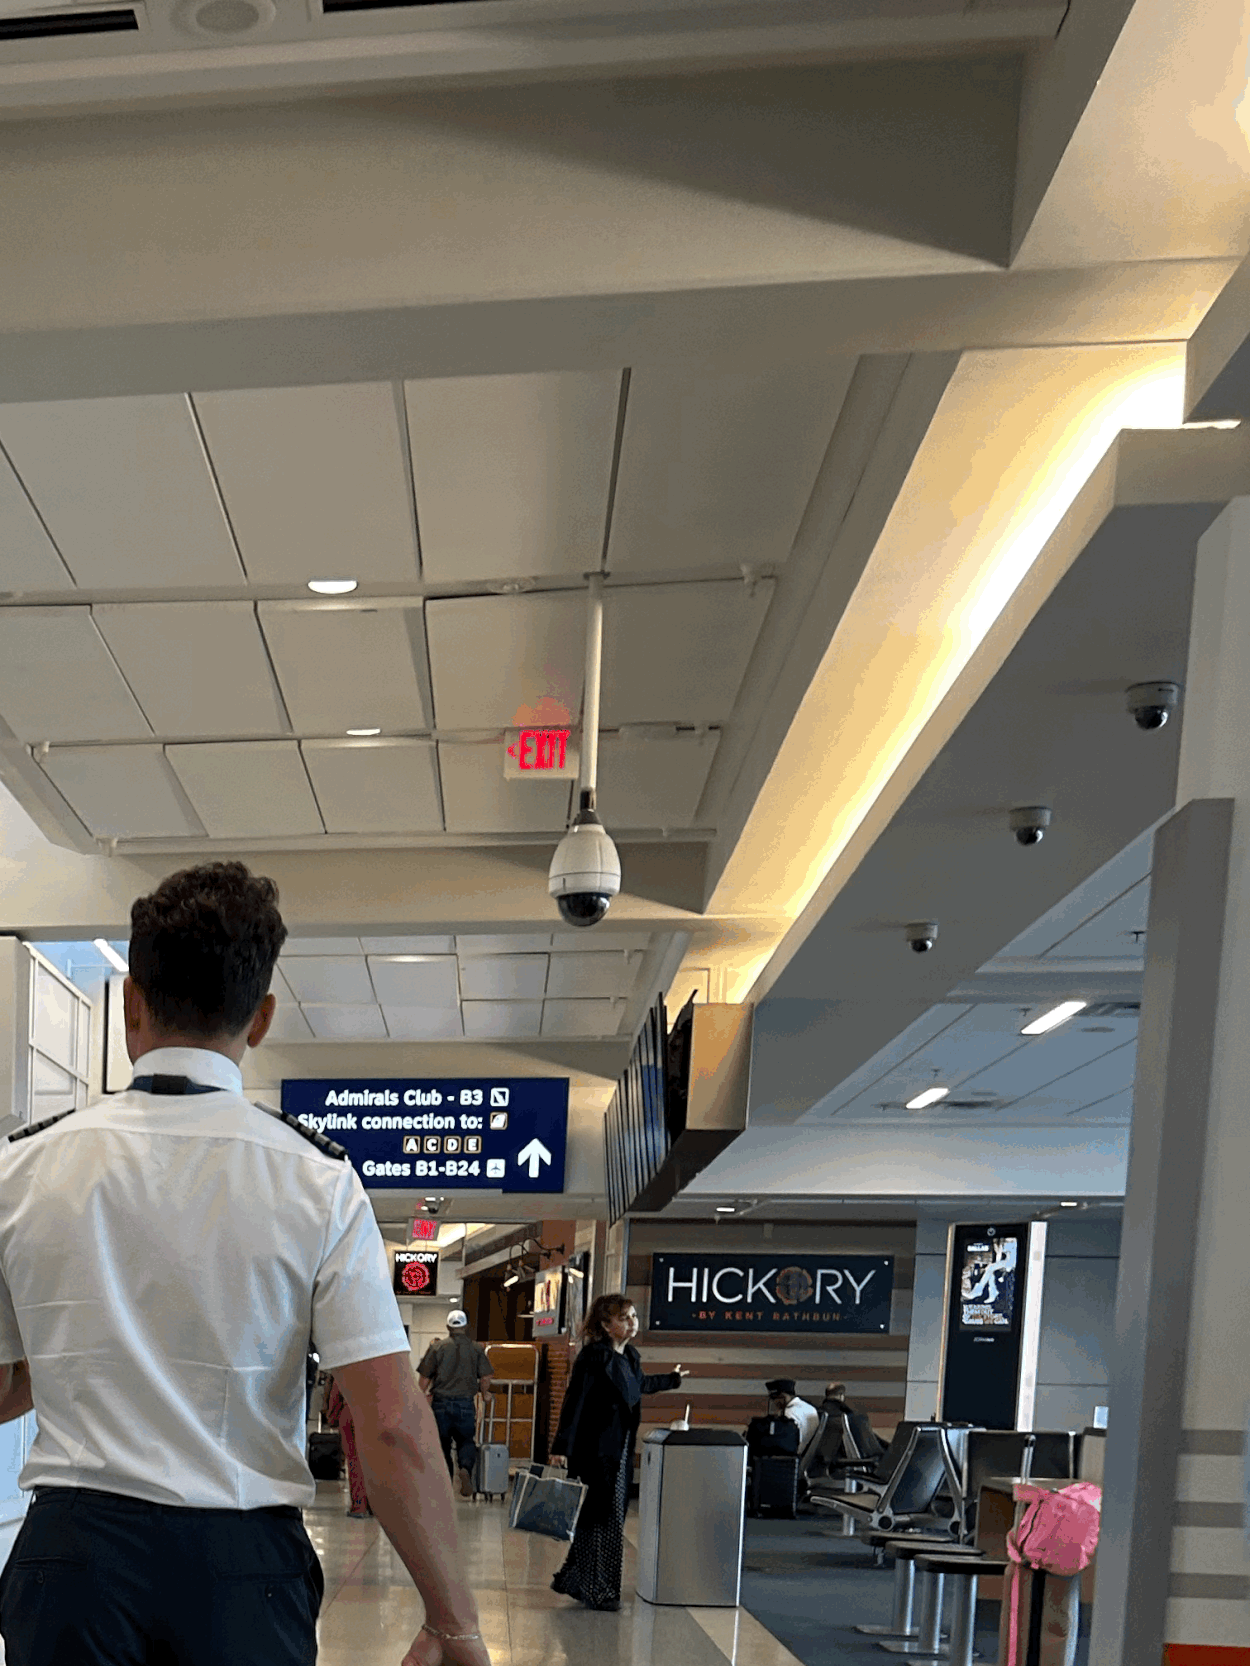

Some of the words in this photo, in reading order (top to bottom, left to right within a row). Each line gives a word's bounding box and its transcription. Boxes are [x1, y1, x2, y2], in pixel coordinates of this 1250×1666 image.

[519, 730, 570, 770] EXIT
[325, 1089, 399, 1106] Admirals
[403, 1089, 442, 1106] Club
[460, 1089, 483, 1106] B3
[298, 1113, 357, 1133] Skylink
[361, 1113, 455, 1130] connection
[460, 1114, 483, 1130] to:
[405, 1138, 418, 1152] A
[426, 1138, 438, 1152] C
[447, 1138, 459, 1152] D
[468, 1138, 478, 1152] E
[362, 1160, 411, 1176] Gates
[415, 1160, 480, 1176] B1-B24
[395, 1252, 437, 1263] HICKORY
[667, 1266, 877, 1306] HICKORY
[698, 1311, 715, 1320] BY
[725, 1311, 763, 1321] KENT
[772, 1311, 841, 1322] RATHBUN
